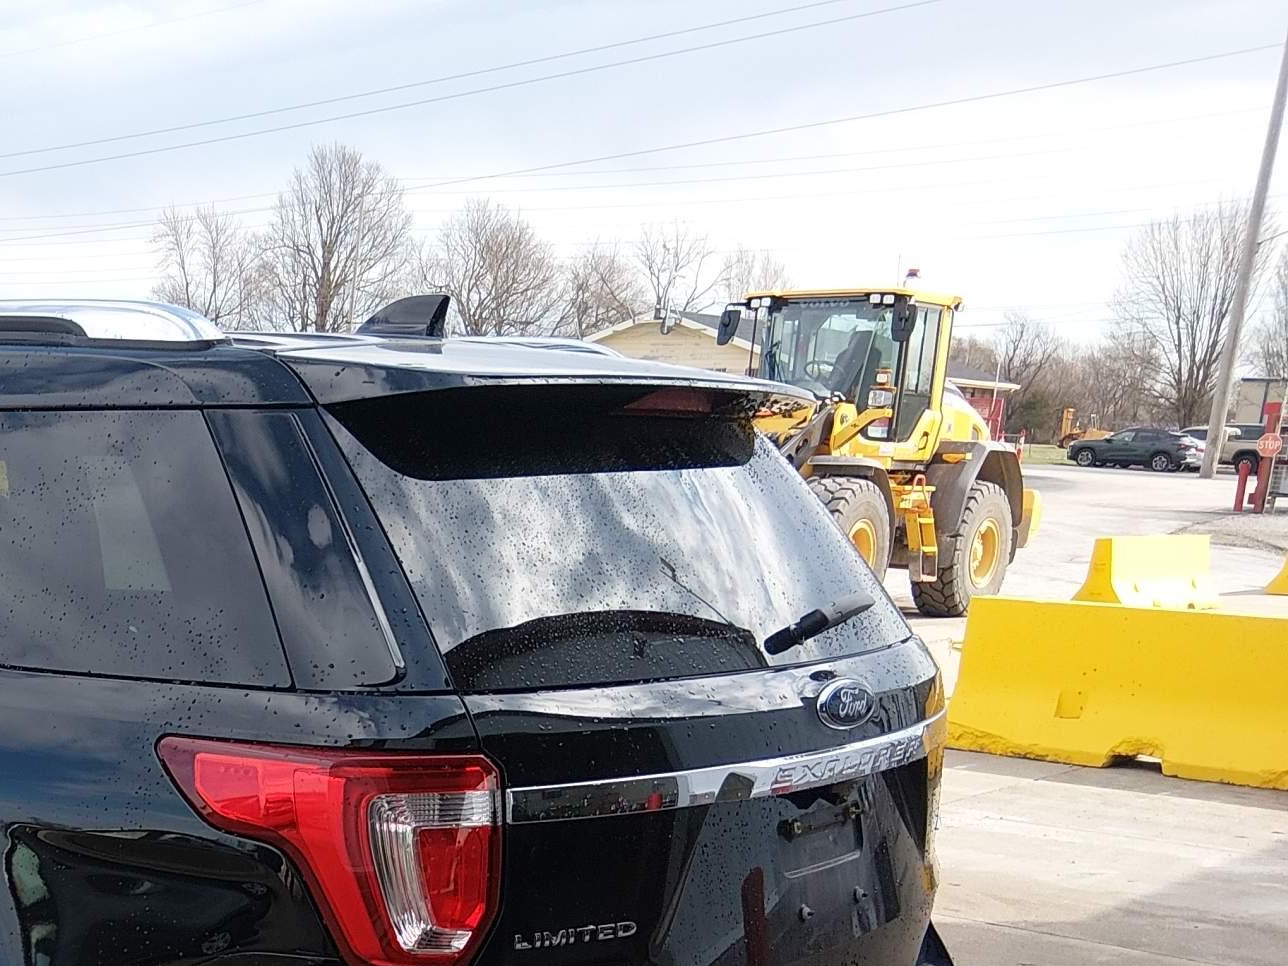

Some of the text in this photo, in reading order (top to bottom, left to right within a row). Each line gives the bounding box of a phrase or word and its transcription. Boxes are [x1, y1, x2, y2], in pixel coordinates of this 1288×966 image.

[1259, 440, 1280, 449] STOP
[838, 688, 868, 718] Ford
[771, 735, 921, 791] EXPLORER
[514, 921, 637, 950] LIMITED
